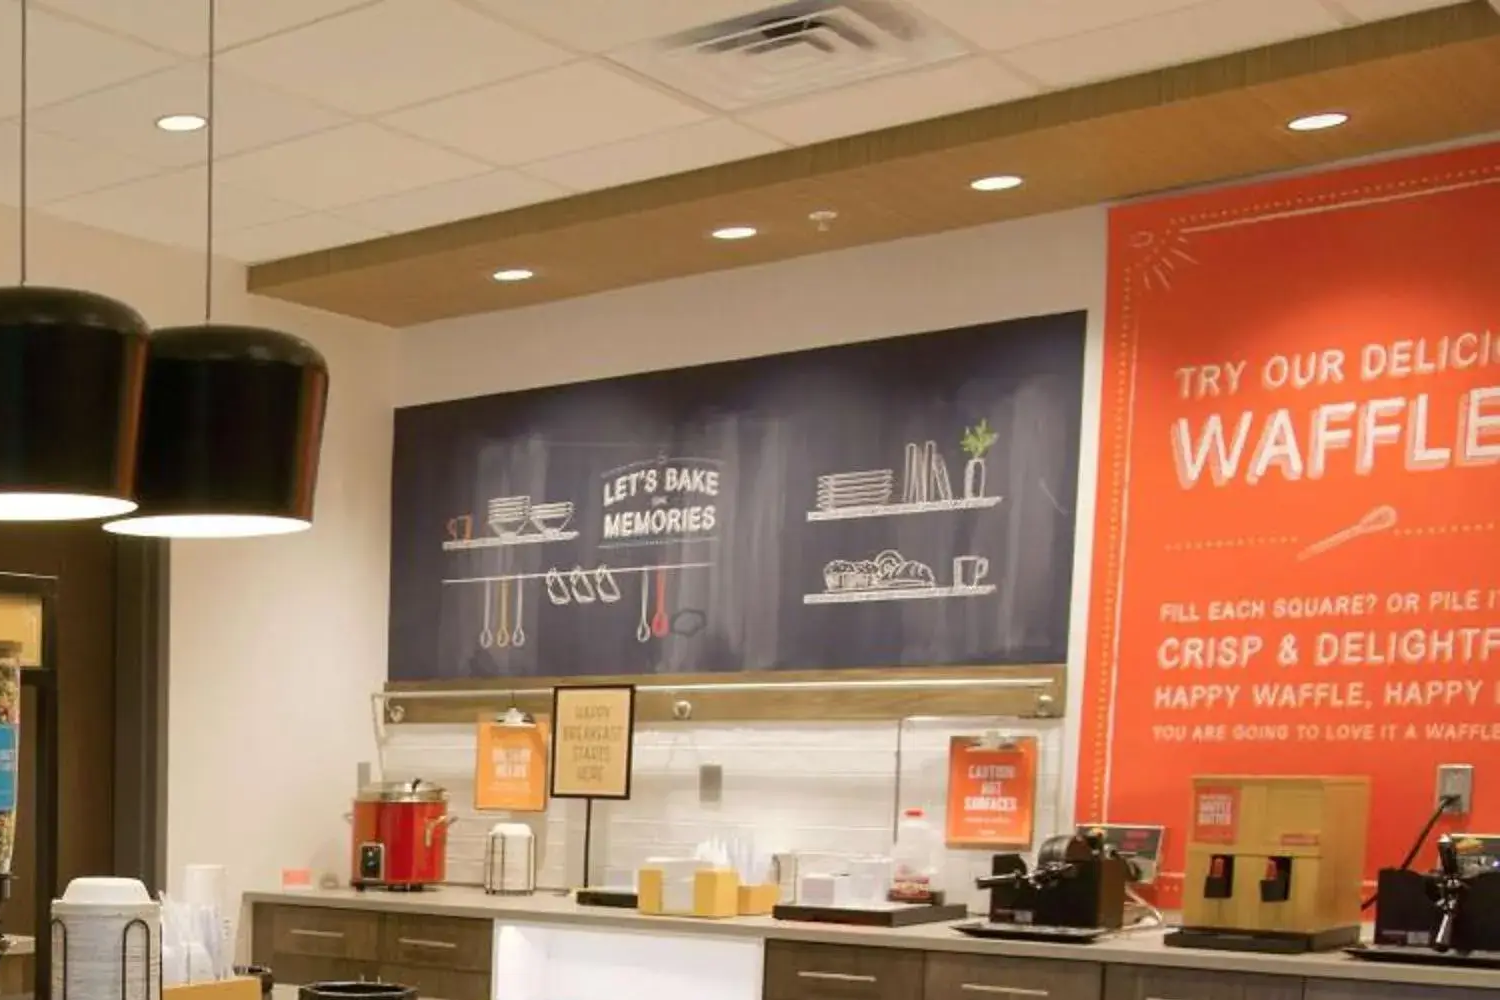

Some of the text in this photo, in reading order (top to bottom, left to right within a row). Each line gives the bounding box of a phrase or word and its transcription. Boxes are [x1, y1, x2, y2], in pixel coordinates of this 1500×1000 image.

[1176, 360, 1246, 398] TRY
[1262, 349, 1345, 388] OUR
[1171, 385, 1500, 490] WAFFLE
[603, 467, 719, 507] LET'S BAKE
[603, 504, 716, 538] MEMORIES
[1159, 601, 1200, 622] FILL
[1208, 599, 1265, 621] EACH
[1272, 592, 1378, 619] SQUARE?
[1386, 591, 1420, 614] OR
[1429, 589, 1481, 612] PILE
[1156, 626, 1500, 670] CRISP & DELIGHTF
[1154, 684, 1240, 710] HAPPY
[1252, 681, 1373, 710] WAFFLE,
[1384, 679, 1483, 706] HAPPY
[1152, 722, 1500, 742] YOU ARE GOING TO LOVE IT A WAFFLE
[968, 764, 1016, 779] CAUTION
